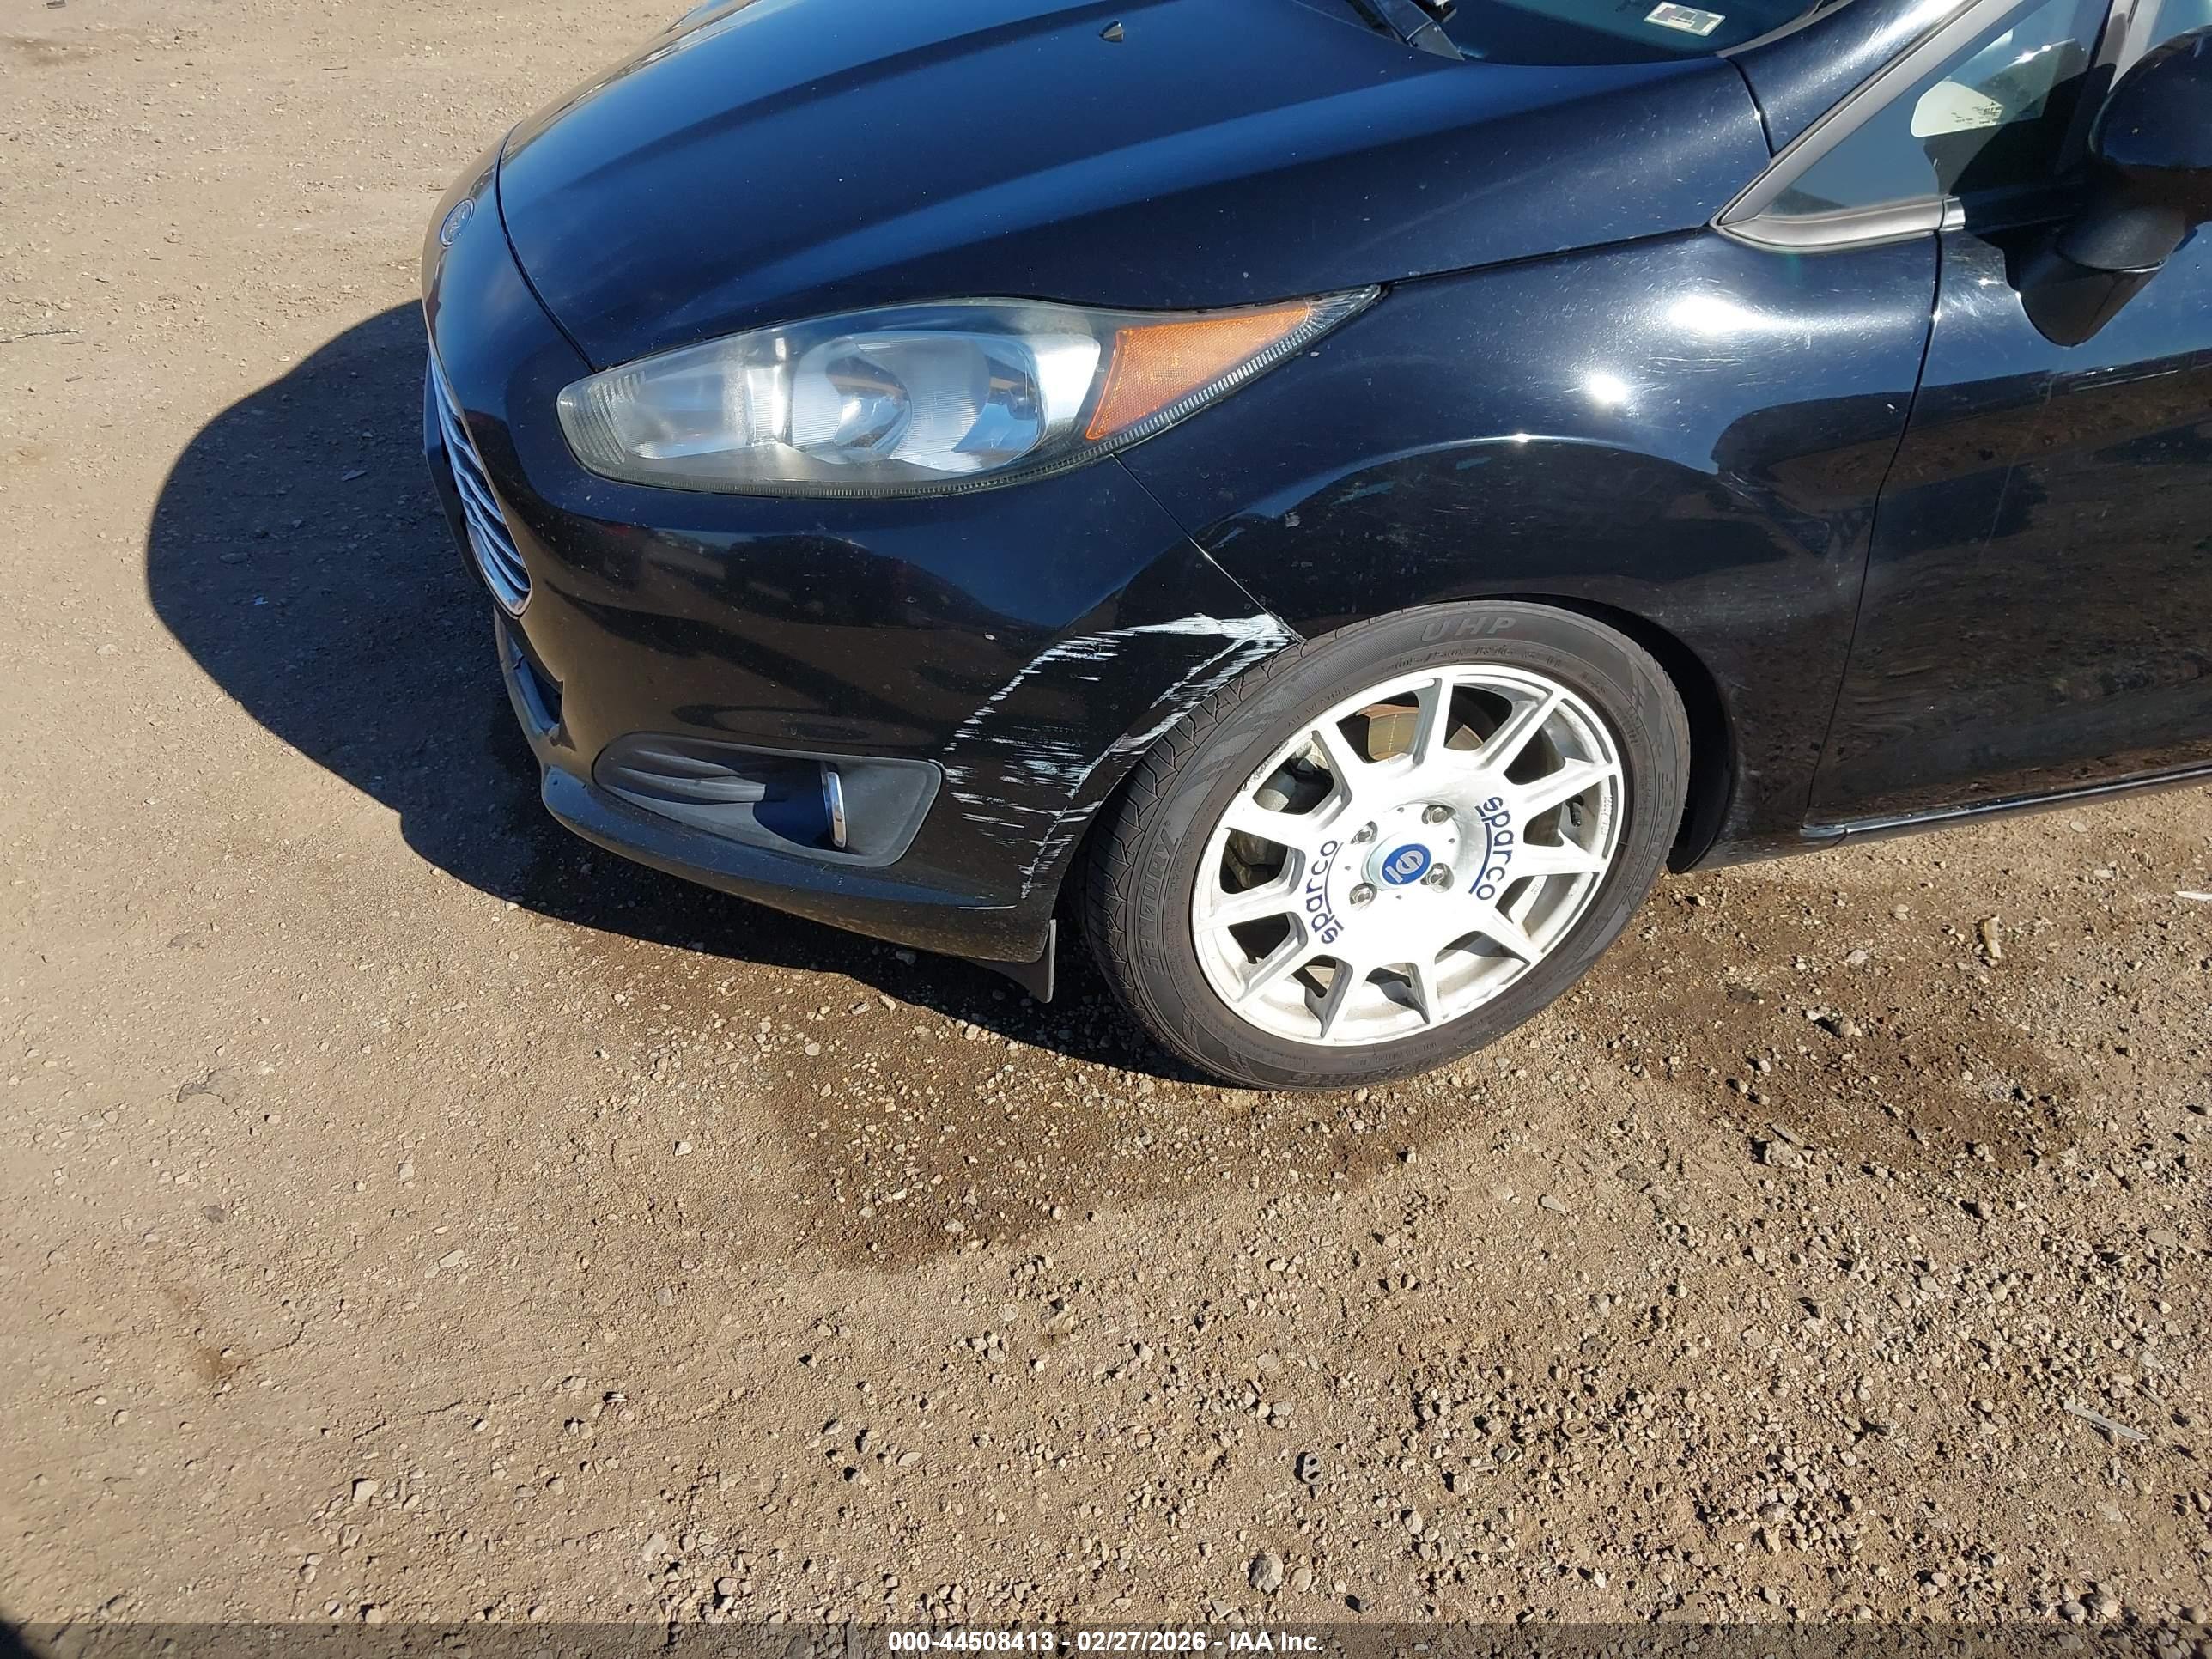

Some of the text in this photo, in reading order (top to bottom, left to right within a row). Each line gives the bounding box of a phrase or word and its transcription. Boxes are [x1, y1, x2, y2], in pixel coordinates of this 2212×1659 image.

[1420, 617, 1516, 642] UHP
[1306, 840, 1340, 945] sparco
[1475, 795, 1514, 901] sparco
